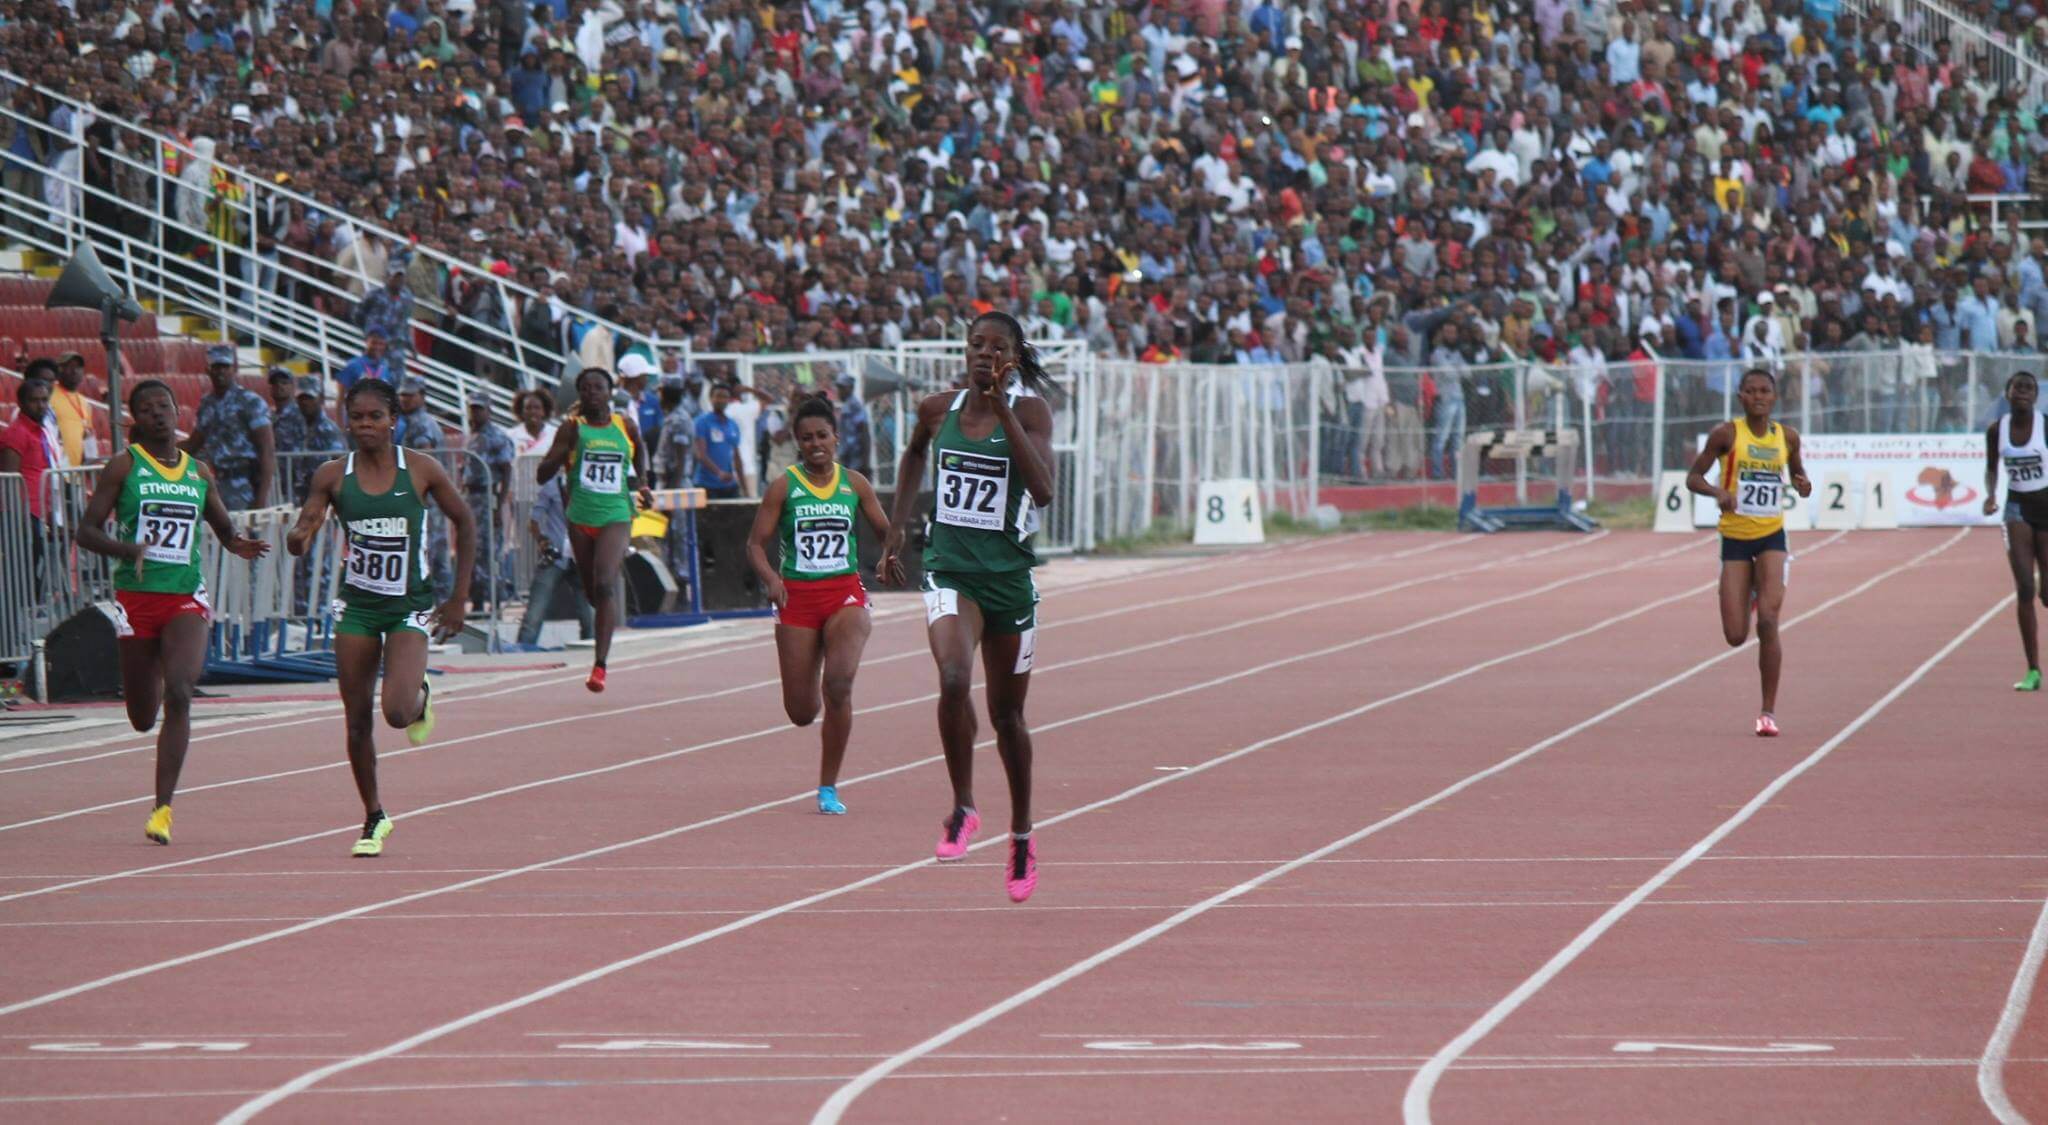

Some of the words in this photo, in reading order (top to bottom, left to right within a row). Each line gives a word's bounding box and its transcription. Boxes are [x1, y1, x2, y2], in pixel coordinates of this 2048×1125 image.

[585, 464, 616, 484] 414
[139, 482, 200, 498] ETHIOPIA
[944, 474, 998, 513] 372
[1666, 484, 1681, 512] 6
[1742, 484, 1777, 507] 261
[1783, 484, 1797, 510] 5
[1828, 482, 1845, 510] 2
[1874, 482, 1883, 509] 1
[794, 504, 852, 518] ETHIOPIA
[1206, 495, 1225, 524] 8
[144, 518, 190, 549] 327
[800, 534, 846, 561] 322
[351, 547, 402, 582] 380
[29, 1041, 249, 1052] 5
[557, 1039, 771, 1051] 4
[1083, 1040, 1304, 1051] 3
[1612, 1040, 1836, 1053] 2
